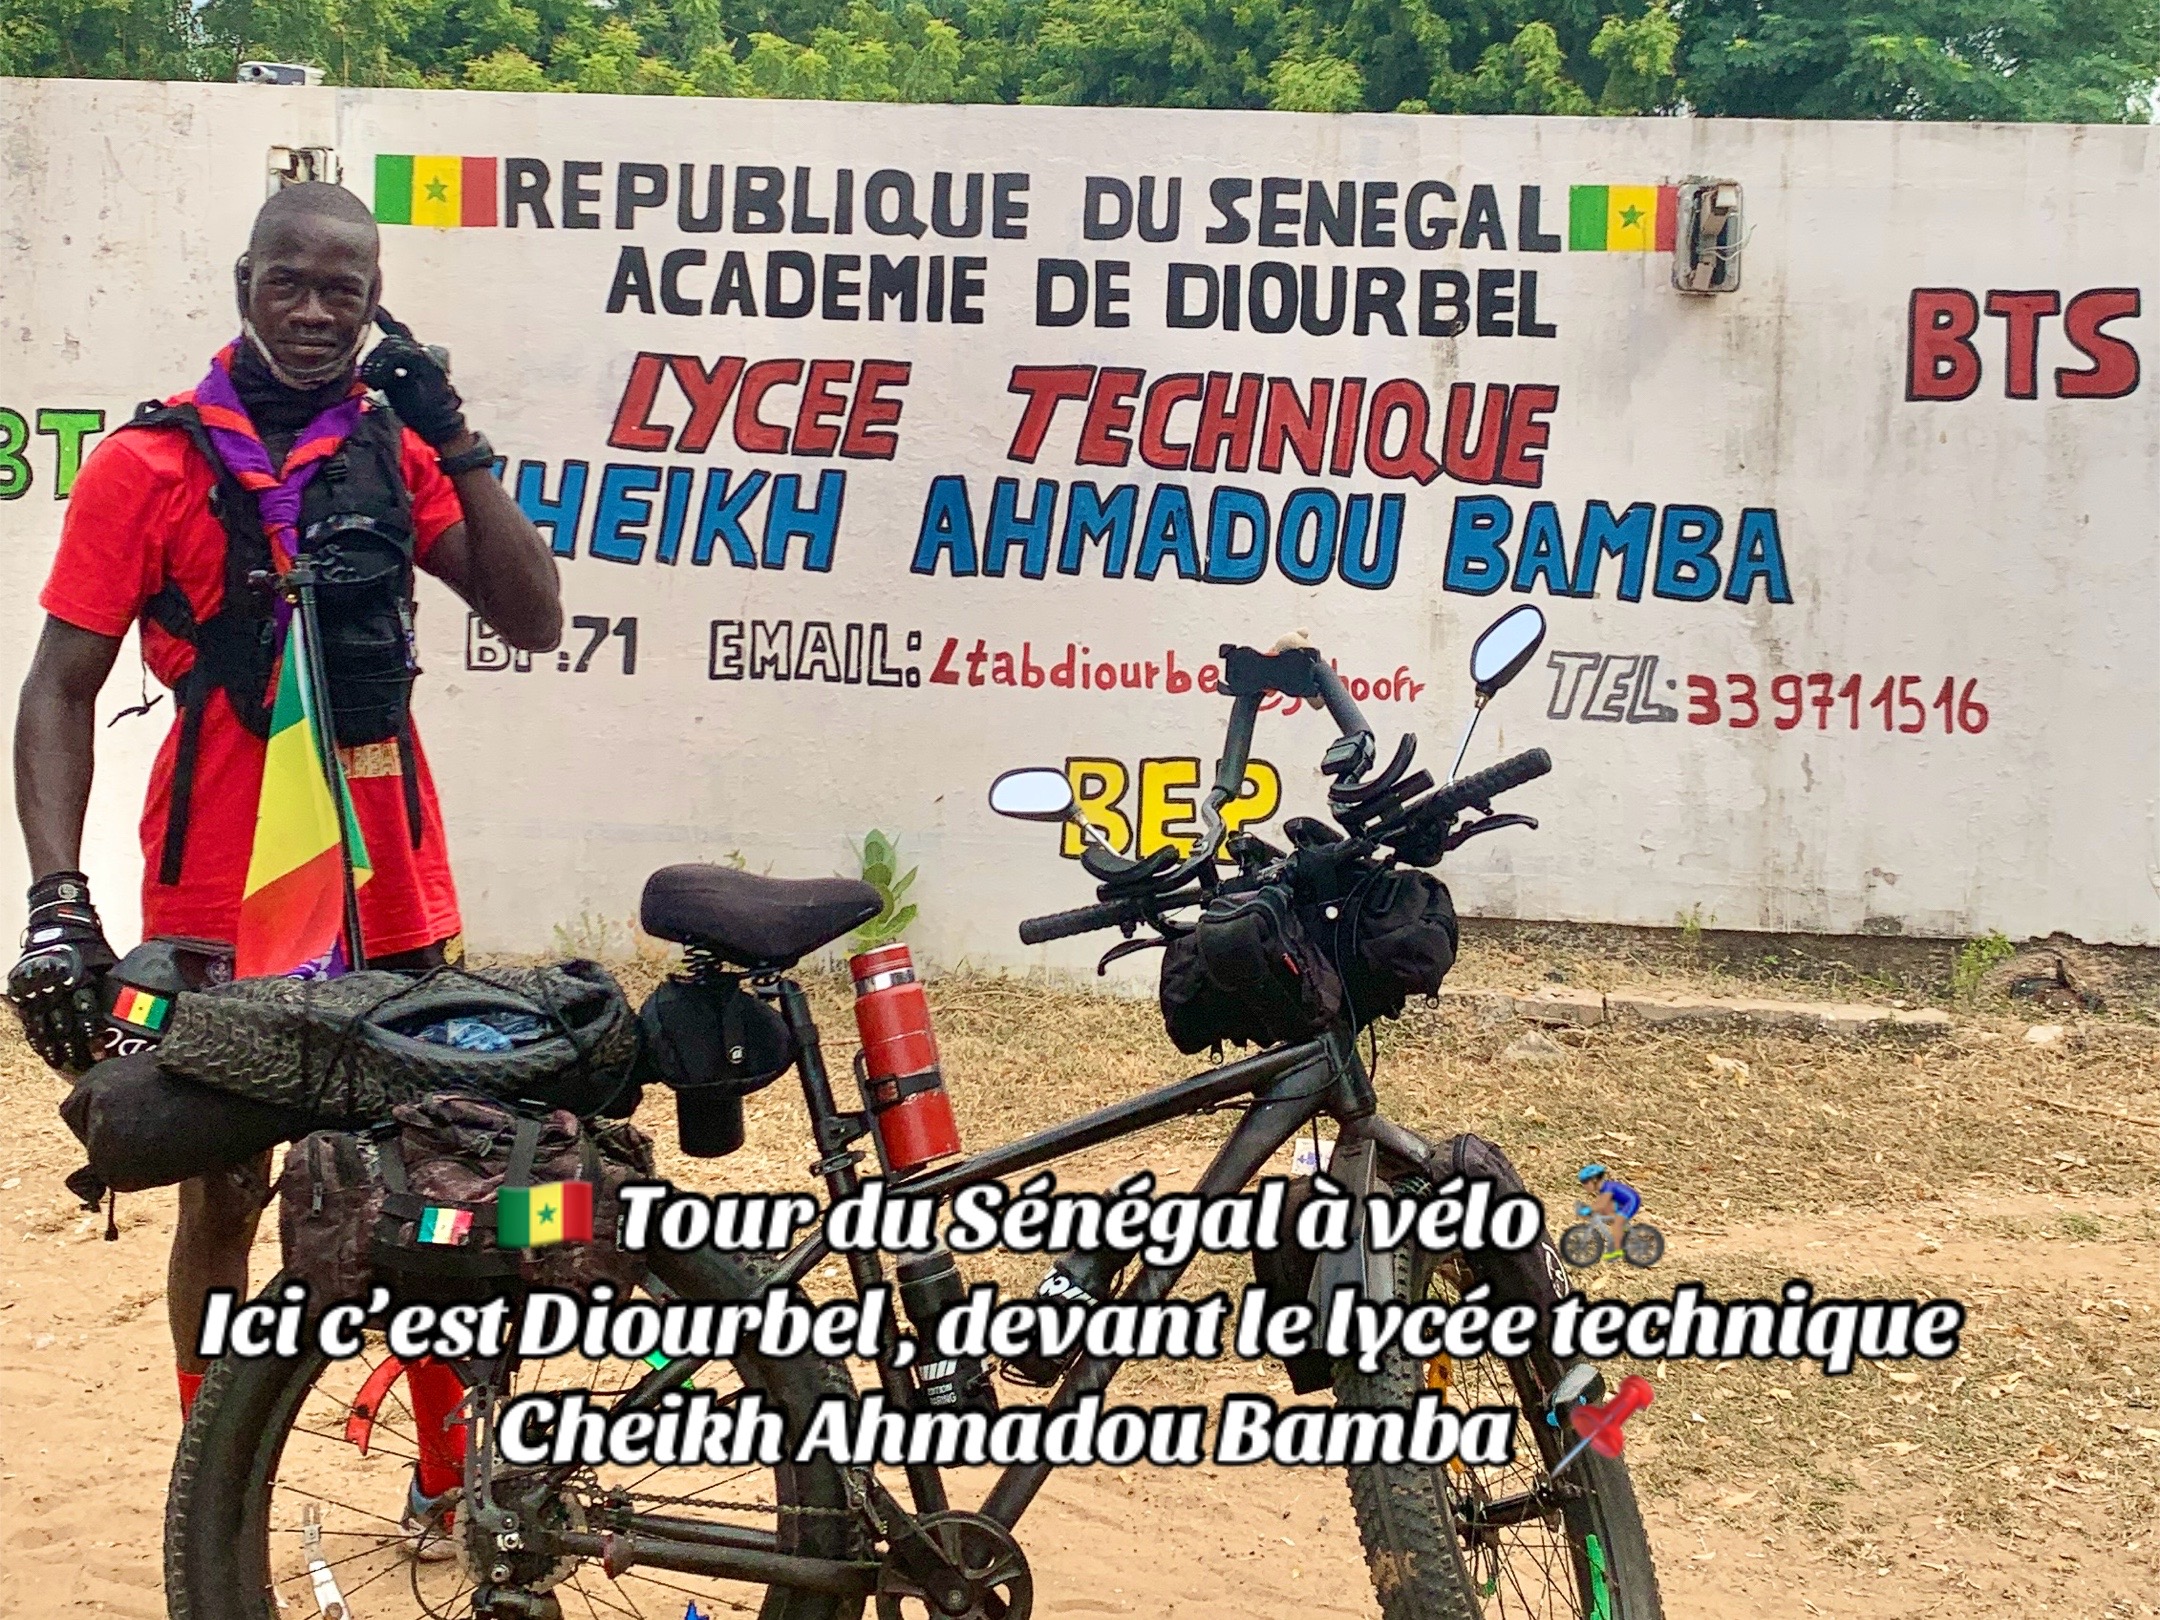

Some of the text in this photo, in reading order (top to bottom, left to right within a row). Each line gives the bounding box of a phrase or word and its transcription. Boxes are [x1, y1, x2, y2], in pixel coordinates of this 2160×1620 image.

[504, 157, 1561, 253] REPUBLIQUE DU SENEGAL
[606, 245, 1557, 338] ACADEMIE DE DIOURBEL
[1904, 287, 2141, 402] BTS
[608, 352, 1560, 487] LYCEE TECHNIQUE
[492, 455, 1794, 604] HEIKH AHMADOU BAMBA
[708, 619, 922, 688] EMAIL:
